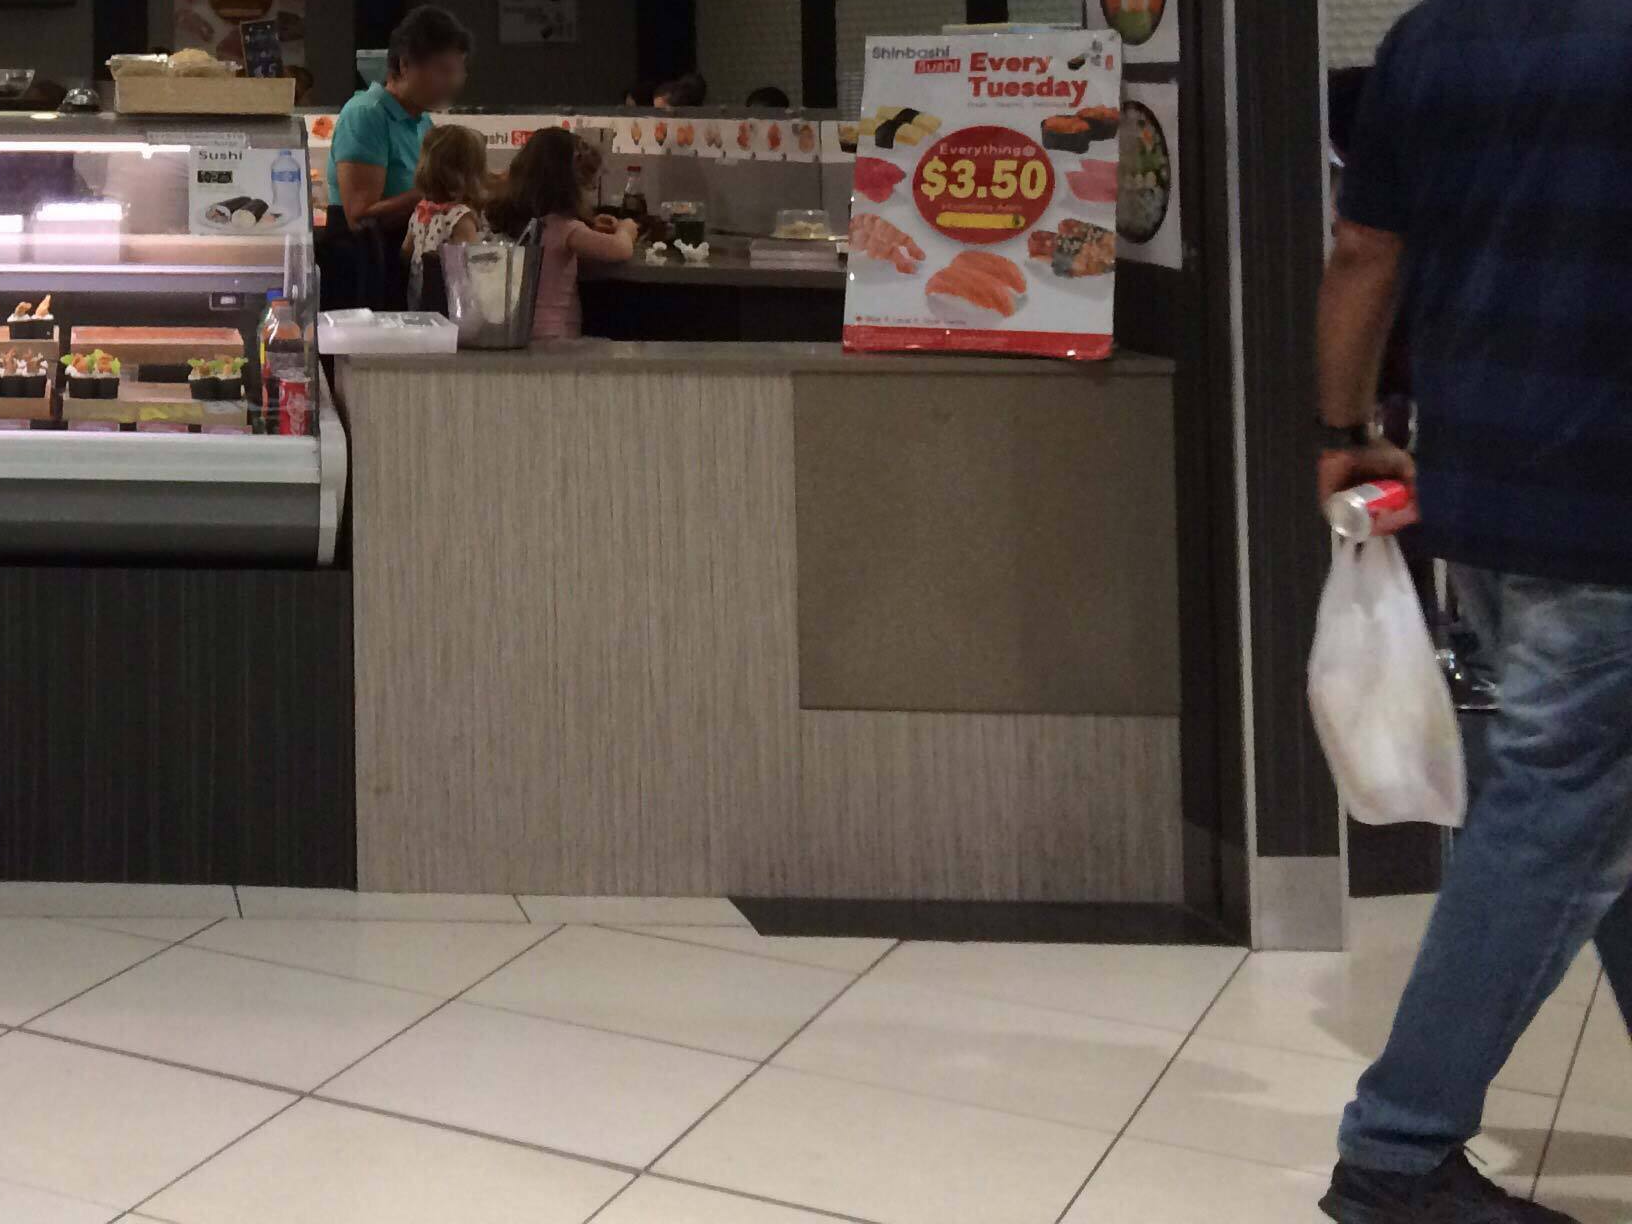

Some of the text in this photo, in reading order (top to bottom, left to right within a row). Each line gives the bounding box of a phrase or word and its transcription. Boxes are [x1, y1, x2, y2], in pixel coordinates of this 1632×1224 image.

[871, 45, 950, 60] Shinbashi
[916, 58, 960, 73] Sushi
[969, 52, 1051, 74] Every
[968, 76, 1088, 107] Tuesday
[198, 150, 243, 161] Sushi
[920, 155, 1048, 202] $3.50
